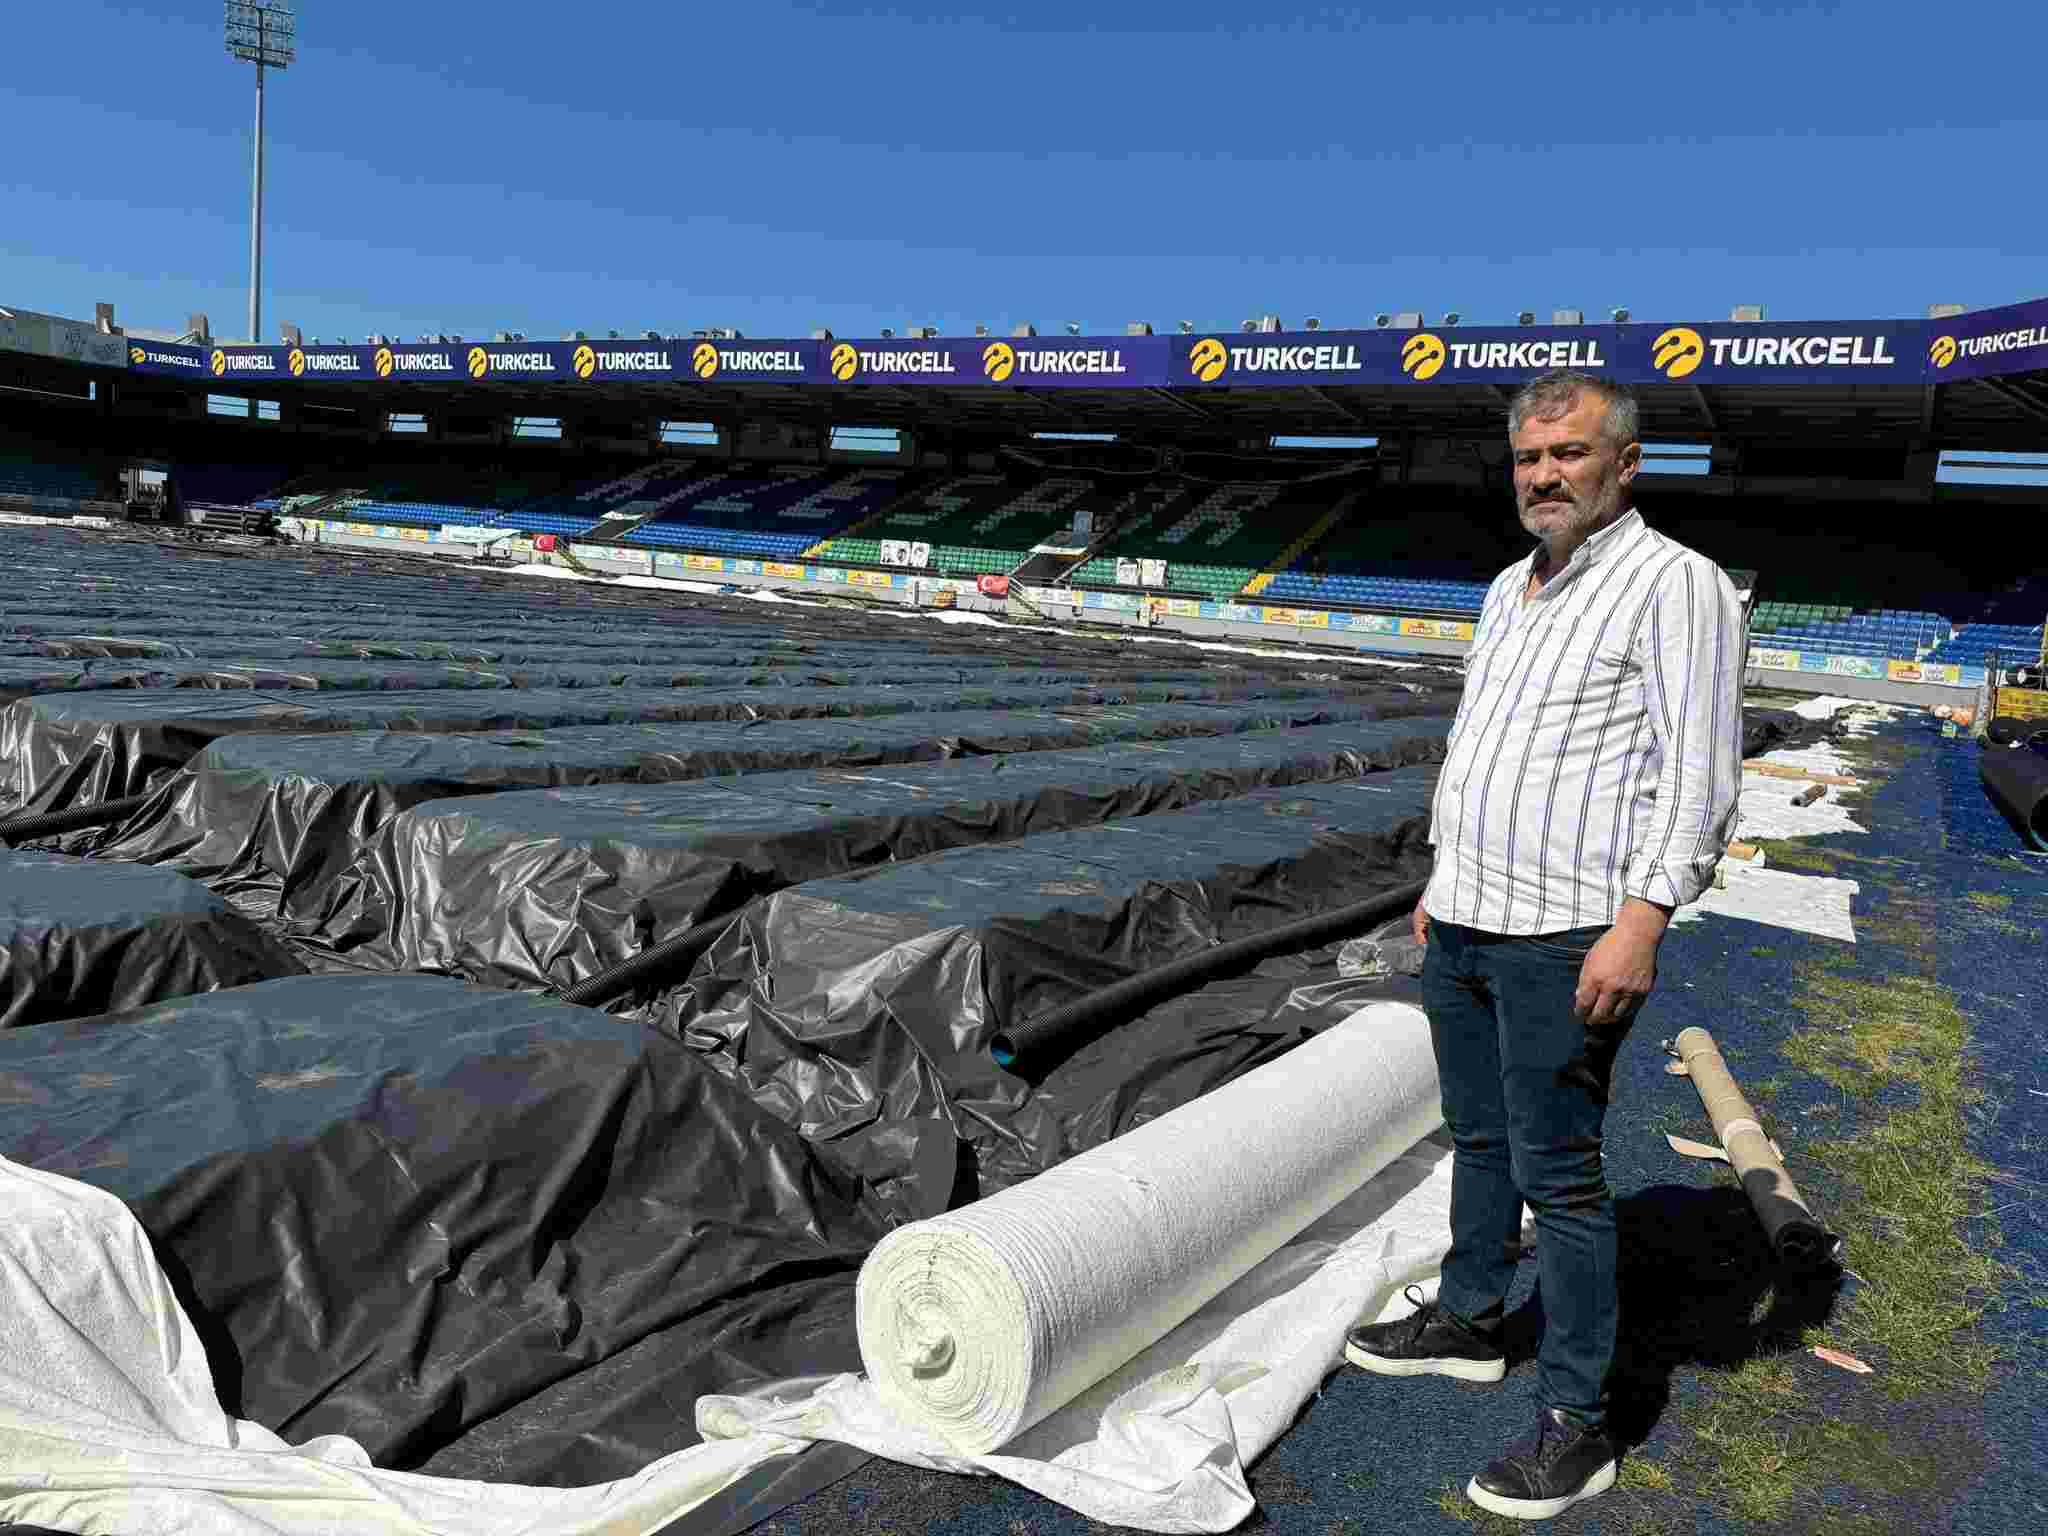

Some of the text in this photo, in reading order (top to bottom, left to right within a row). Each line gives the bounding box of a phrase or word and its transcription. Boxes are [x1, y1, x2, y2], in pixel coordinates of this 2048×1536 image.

[1710, 337, 1894, 366] TURKCELL
[1958, 326, 2048, 357] TURKCELL
[146, 351, 201, 368] TURKCELL
[225, 354, 276, 370] TURKCELL
[305, 354, 361, 371] TURKCELL
[393, 353, 454, 370] TURKCELL
[487, 353, 555, 371] TURKCELL
[596, 352, 672, 371] TURKCELL
[719, 351, 805, 371] TURKCELL
[859, 351, 955, 373] TURKCELL
[1016, 351, 1126, 373] TURKCELL
[1230, 346, 1361, 372] TURKCELL
[1450, 342, 1605, 369] TURKCELL
